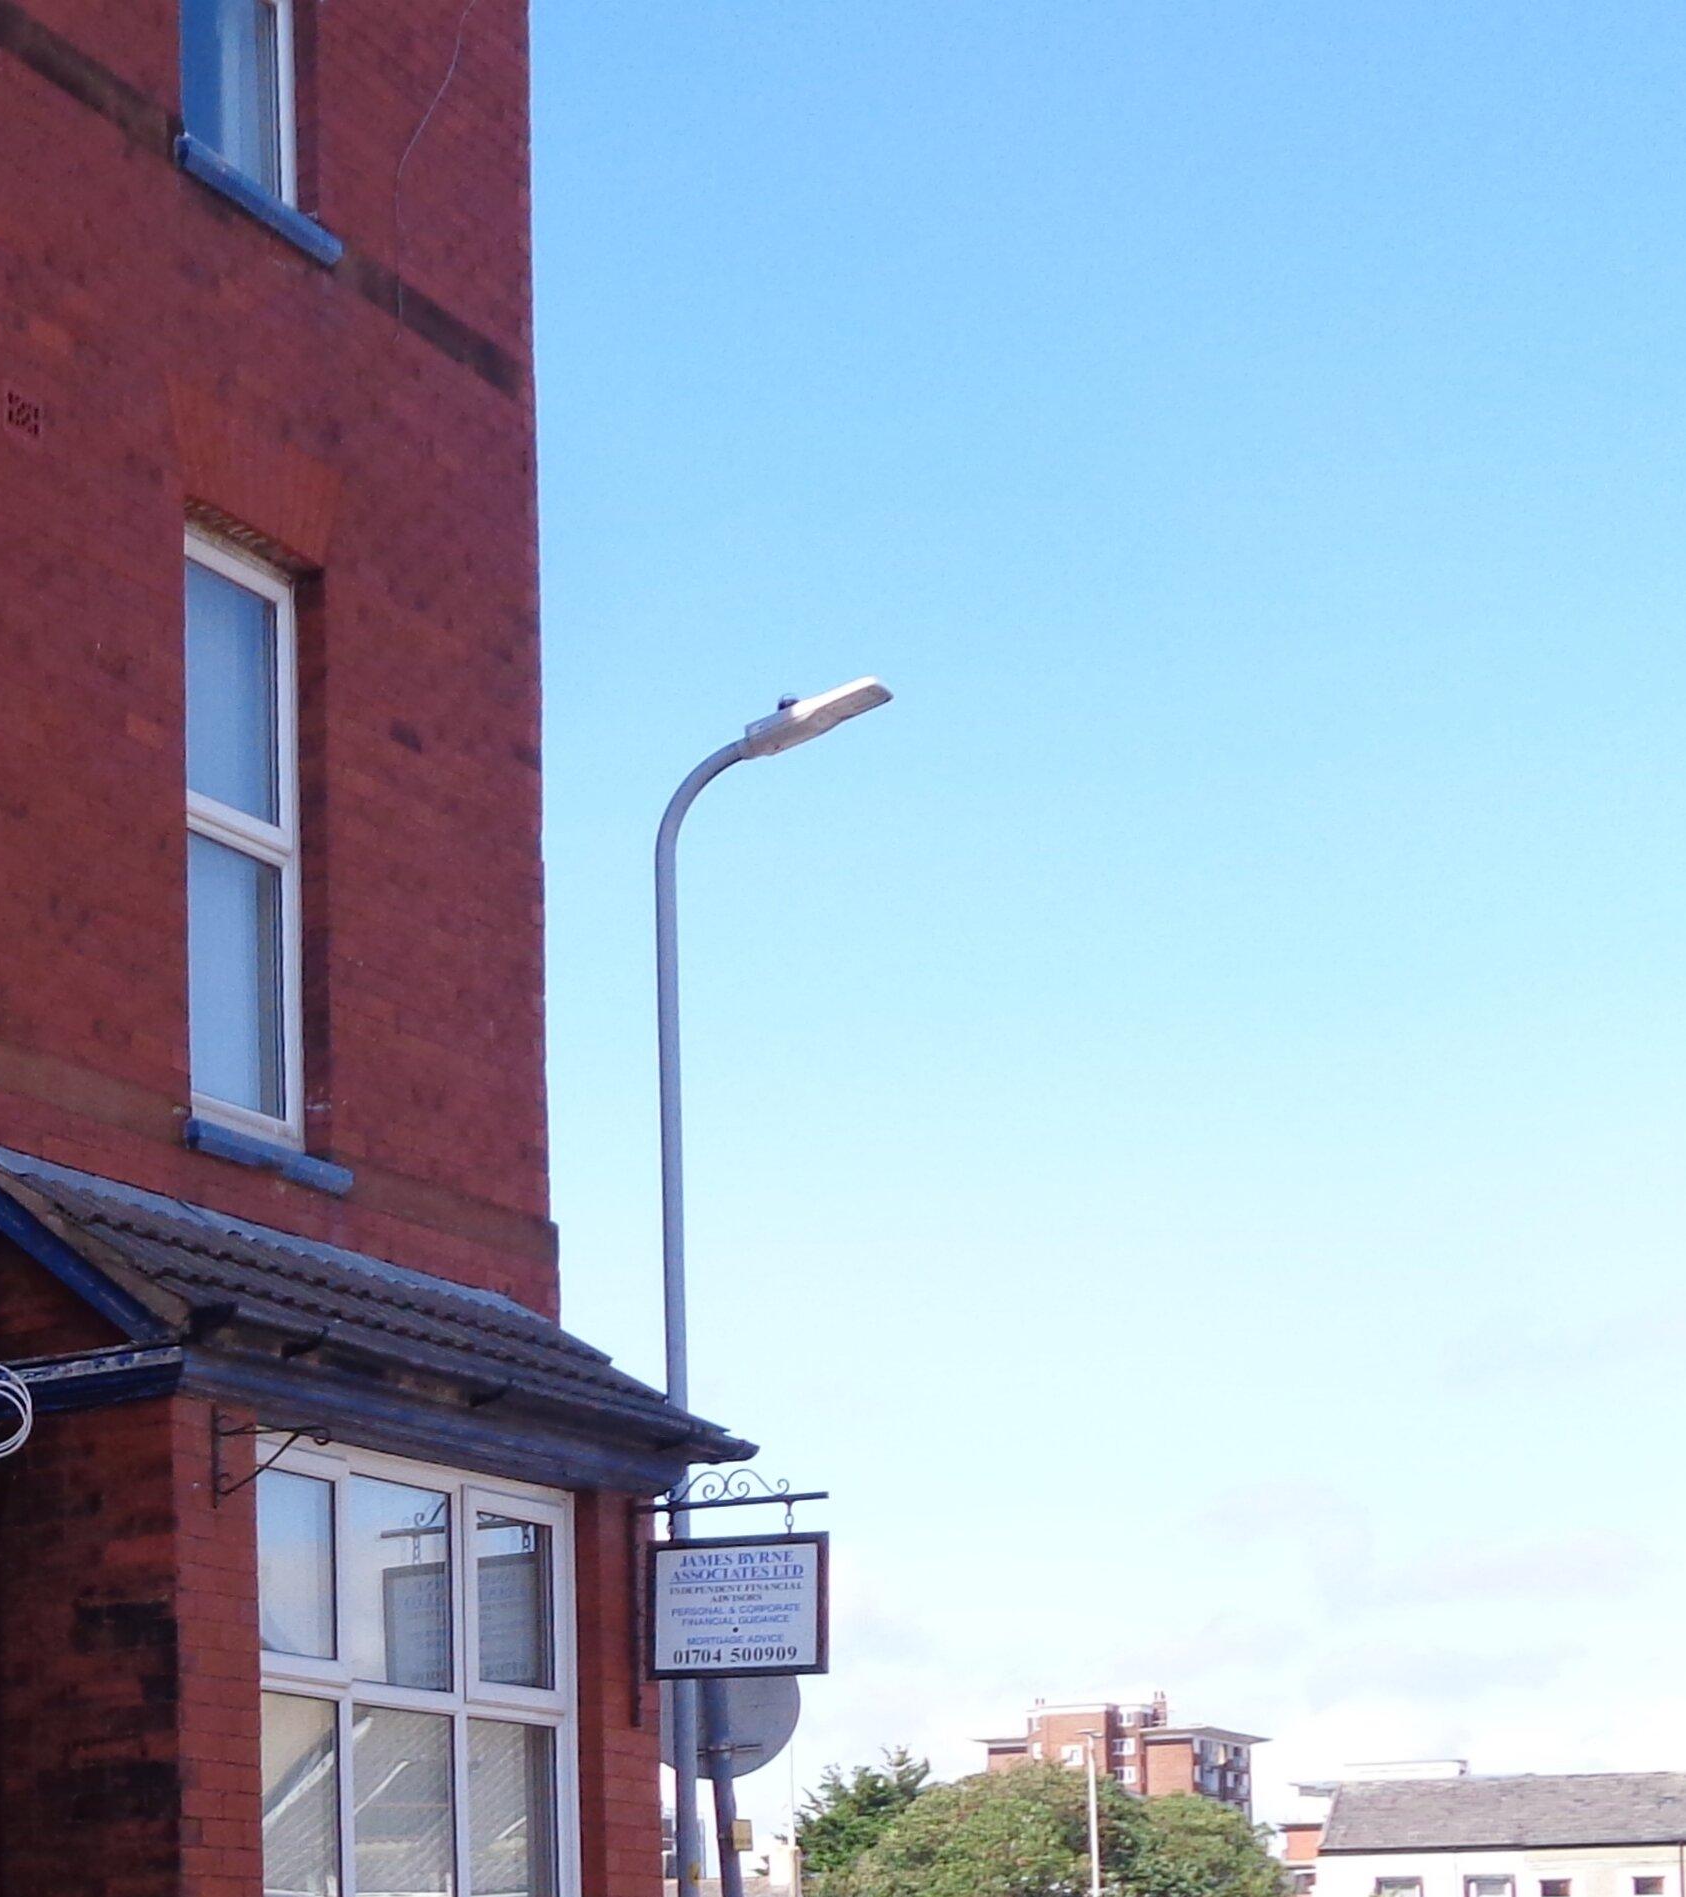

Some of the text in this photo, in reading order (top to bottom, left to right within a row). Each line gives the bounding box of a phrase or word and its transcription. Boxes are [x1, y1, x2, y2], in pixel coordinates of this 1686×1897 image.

[679, 1550, 794, 1568] JAMES BYRNE
[671, 1563, 804, 1581] ASSOCIATES LTD
[670, 1581, 802, 1595] INDEPENDENT FINANCIAL
[671, 1606, 725, 1616] PERSONAL
[682, 1616, 736, 1626] FINANCIAL
[687, 1633, 784, 1646] MORTGAGE ADVICE
[673, 1646, 798, 1665] 01704 500909
